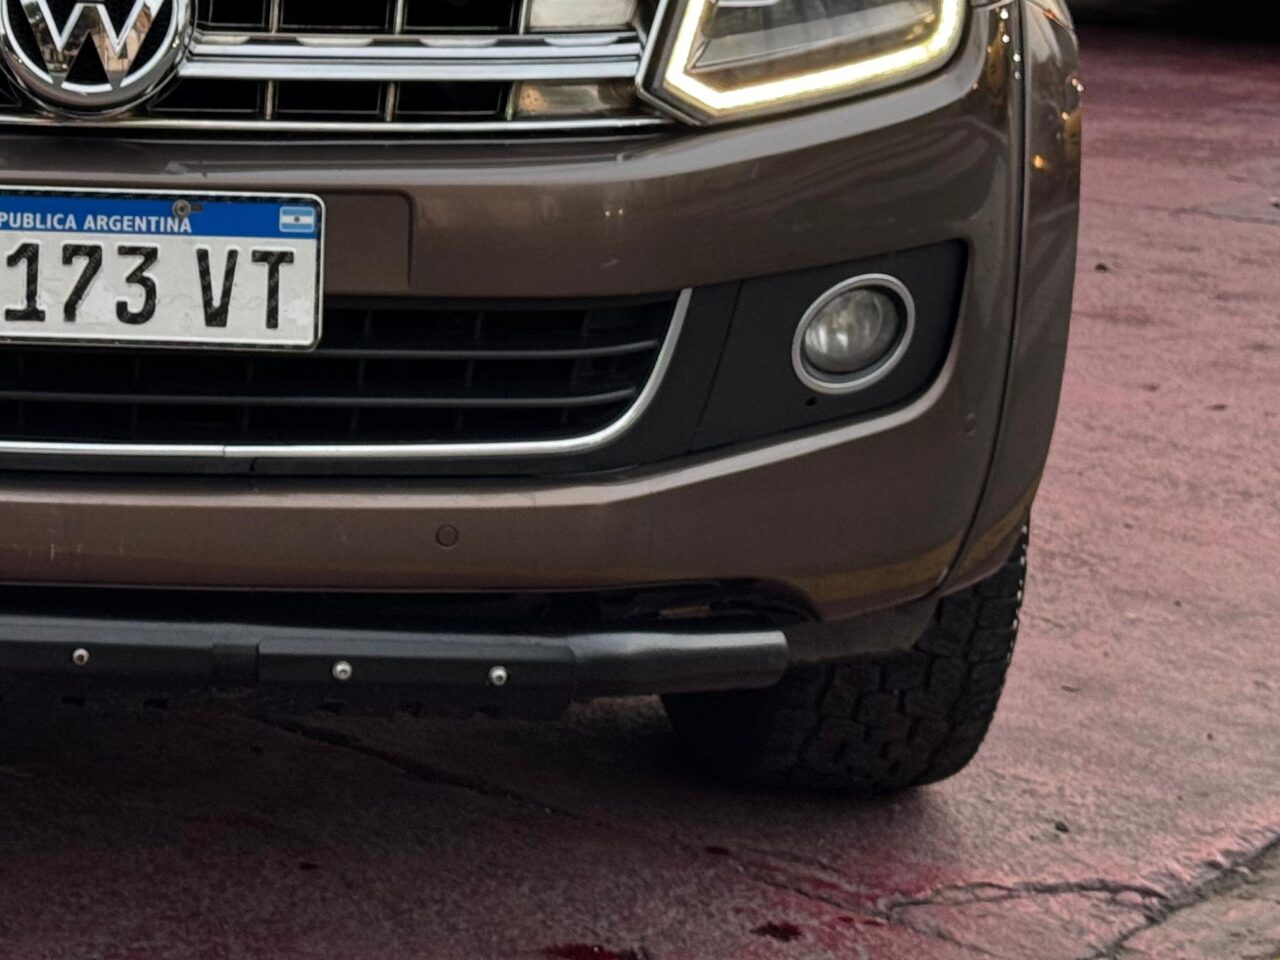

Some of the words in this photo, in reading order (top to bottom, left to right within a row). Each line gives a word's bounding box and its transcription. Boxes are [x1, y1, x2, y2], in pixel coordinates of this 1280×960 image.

[83, 214, 193, 233] ARGENTINA
[4, 243, 159, 325] 173
[196, 248, 295, 330] VT
